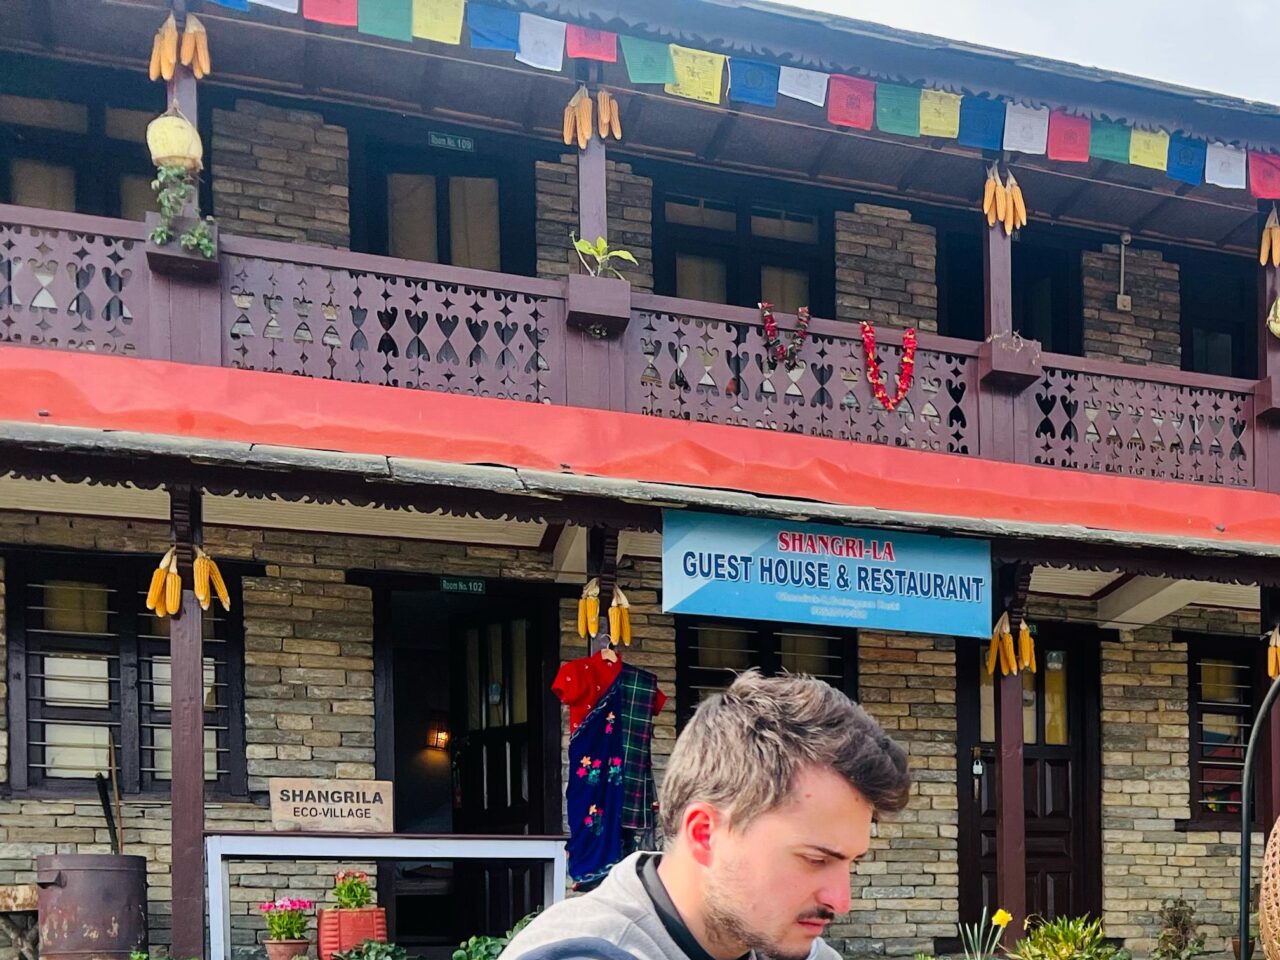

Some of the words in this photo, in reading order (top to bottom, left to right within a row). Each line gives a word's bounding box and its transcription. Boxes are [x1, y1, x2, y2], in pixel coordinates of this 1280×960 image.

[778, 531, 895, 562] SHANGRI-LA
[682, 550, 753, 583] GUEST
[759, 557, 830, 589] HOUSE
[836, 563, 851, 591] &
[856, 565, 984, 602] RESTAURANT
[468, 581, 483, 592] 102
[279, 789, 384, 805] SHANGRILA
[293, 807, 371, 818] ECO-VILLAGE
